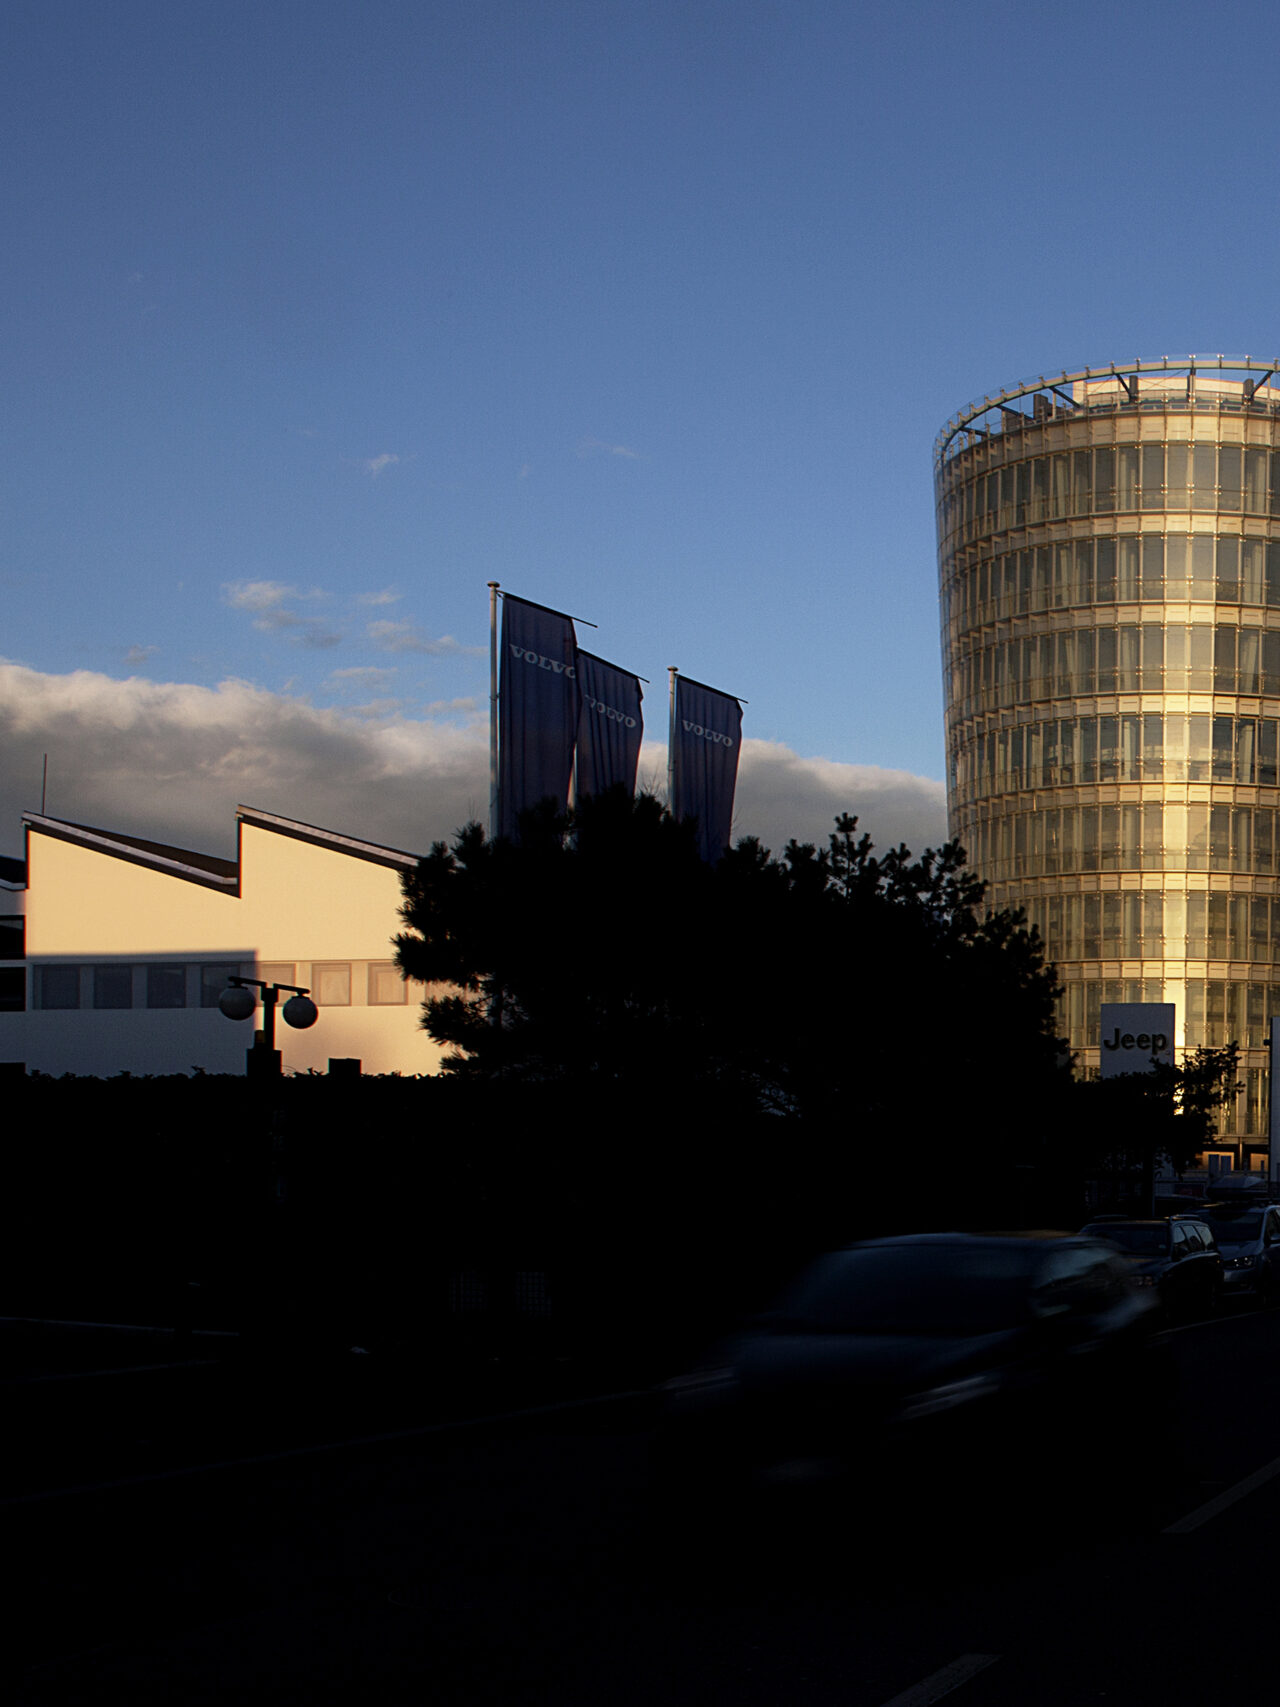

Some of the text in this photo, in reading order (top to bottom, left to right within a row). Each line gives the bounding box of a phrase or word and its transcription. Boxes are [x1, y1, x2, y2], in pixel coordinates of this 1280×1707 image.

[509, 643, 576, 679] VOLVO
[682, 719, 734, 748] VOLVO
[1103, 1027, 1167, 1055] Jeep
